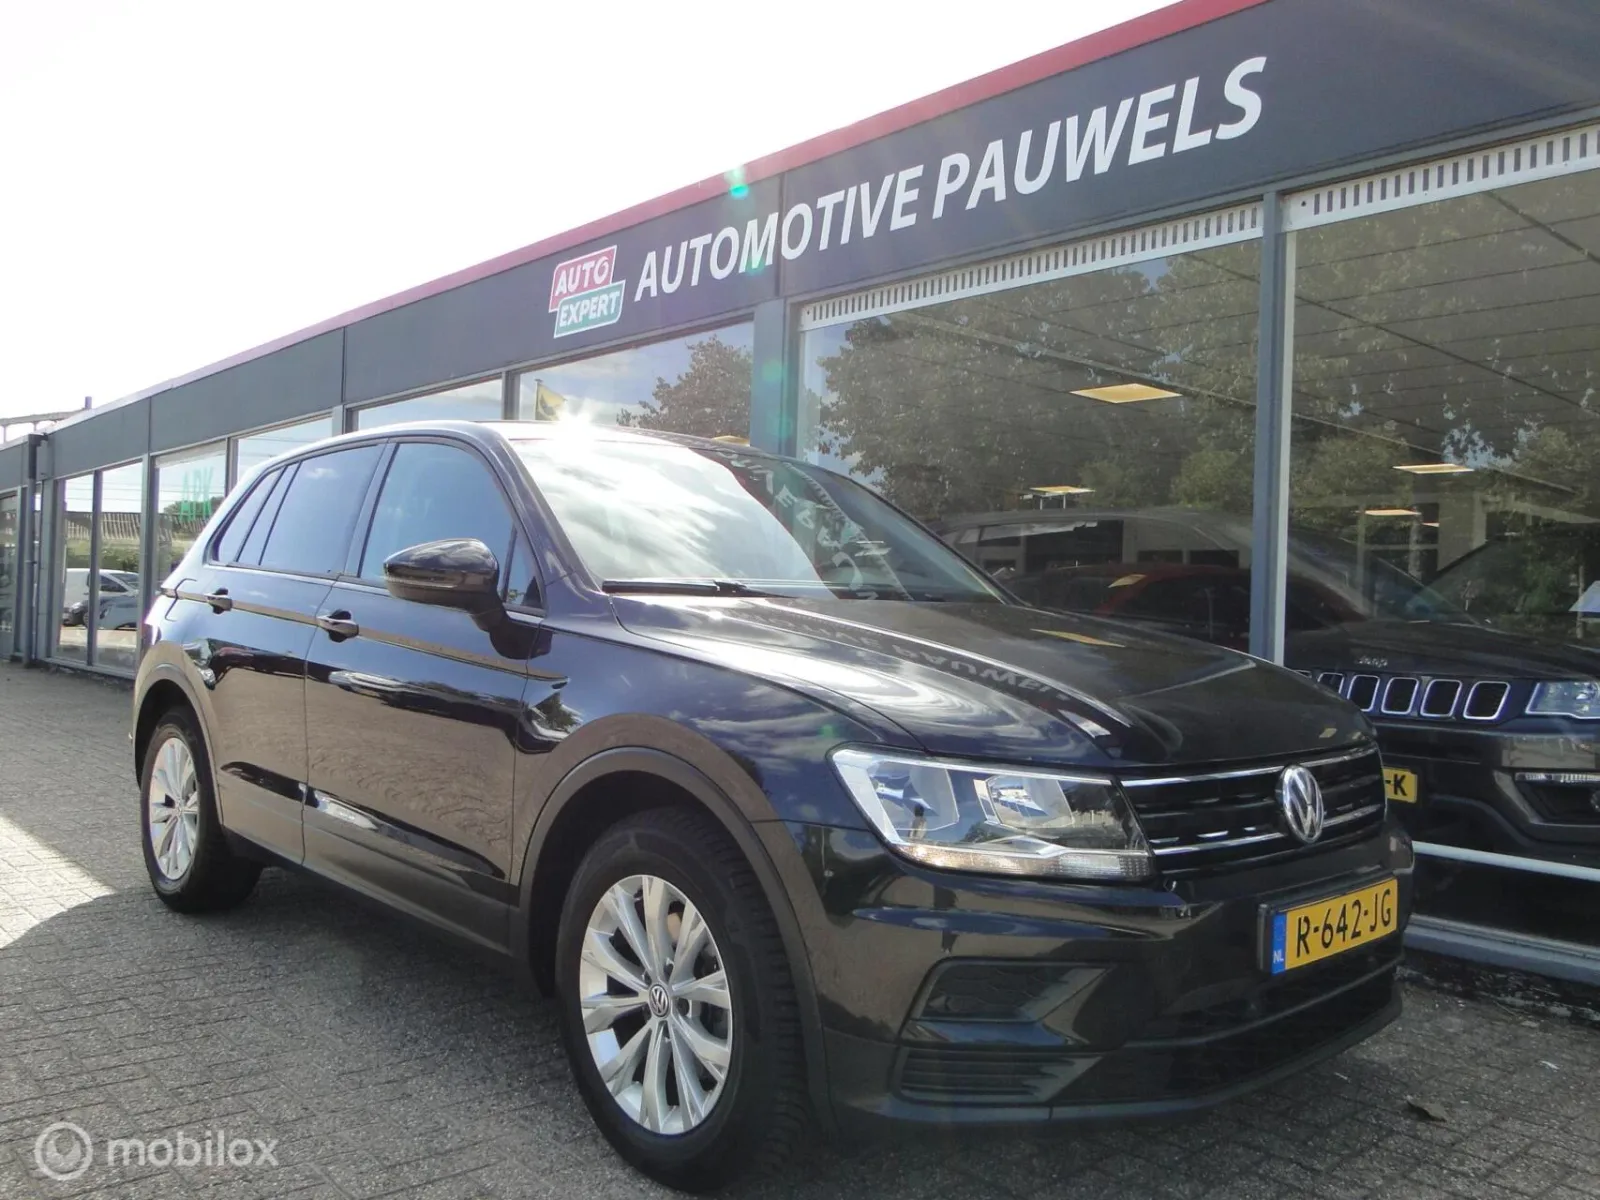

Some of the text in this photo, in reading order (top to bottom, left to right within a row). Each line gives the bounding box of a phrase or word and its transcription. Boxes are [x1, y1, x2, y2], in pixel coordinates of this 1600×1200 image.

[634, 56, 1267, 302] AUTOMOTIVE PAUWELS
[555, 256, 609, 296] AUTO
[560, 291, 620, 327] EXPERT
[1296, 889, 1391, 957] R-642-JG
[1273, 950, 1284, 963] NL
